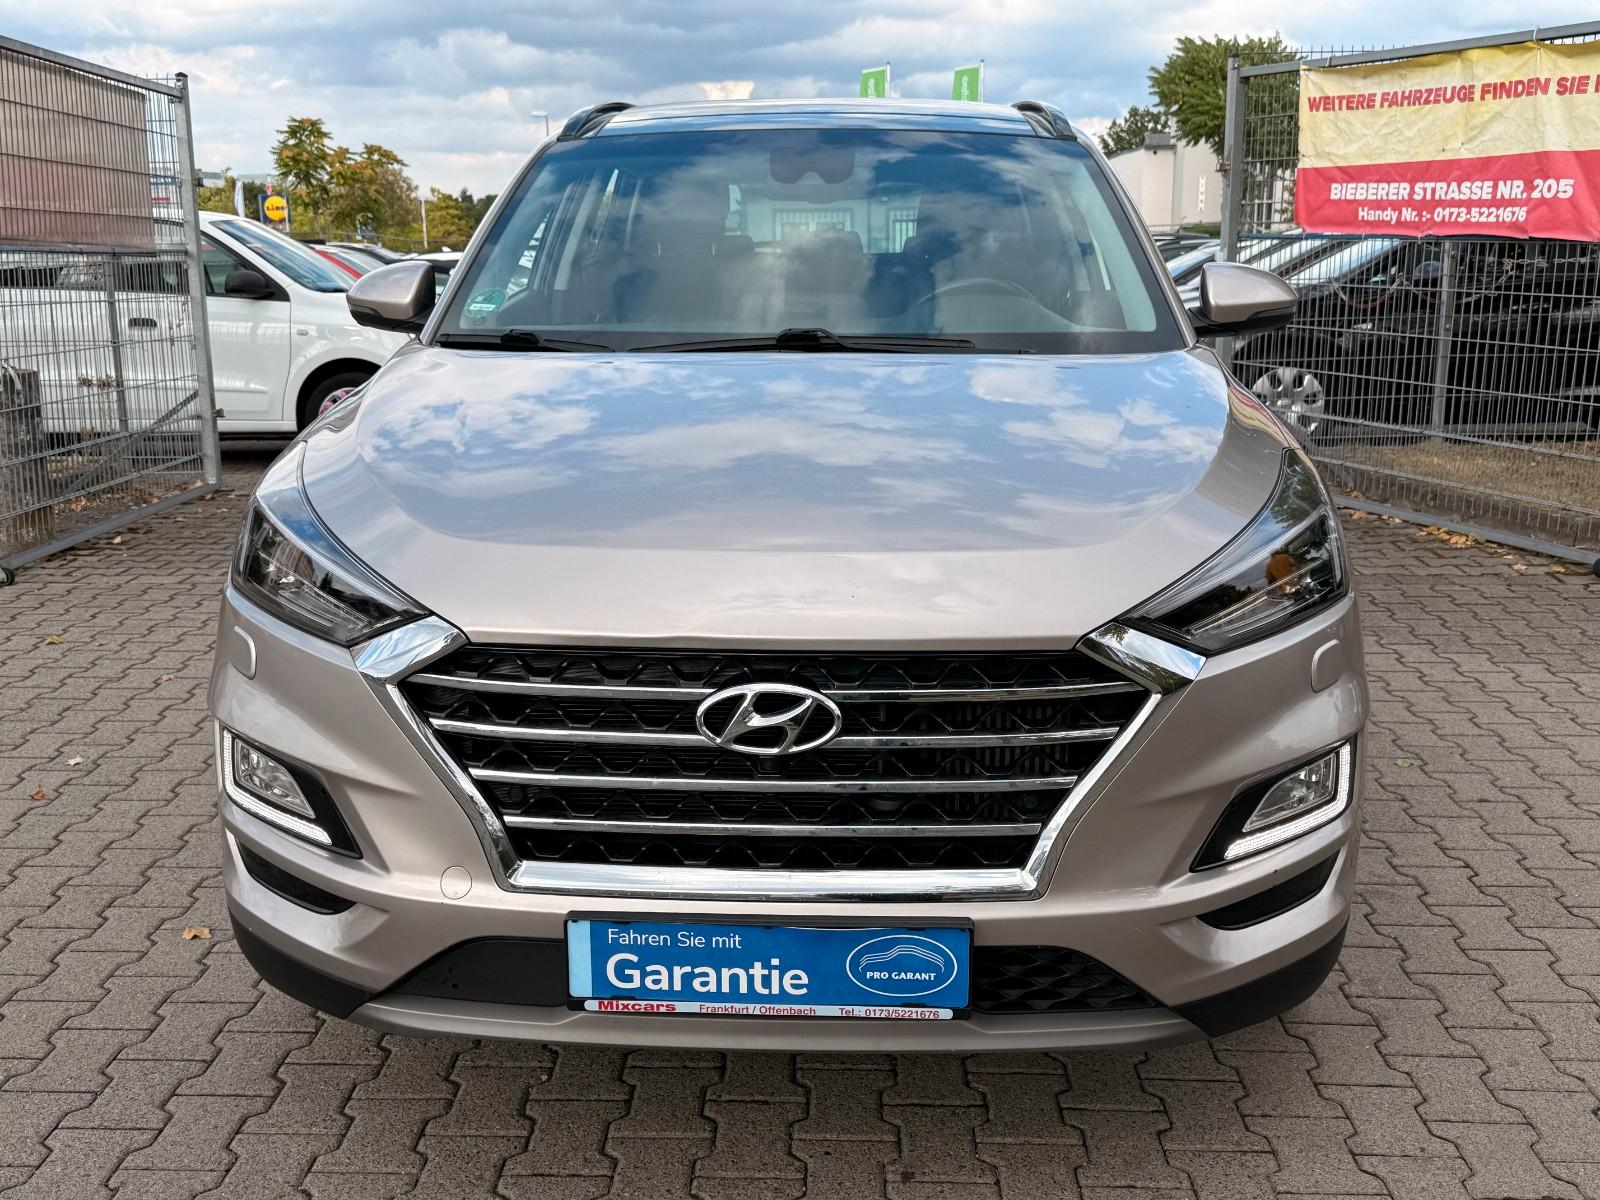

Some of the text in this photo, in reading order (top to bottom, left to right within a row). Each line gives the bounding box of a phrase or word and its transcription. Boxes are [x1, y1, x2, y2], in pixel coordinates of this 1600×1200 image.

[1308, 92, 1377, 112] WEITERE
[1380, 84, 1475, 108] FAHRZEUGE
[1480, 77, 1551, 101] FINDEN
[1556, 75, 1590, 96] SIE
[1330, 178, 1575, 200] BIEBERER STRASSE NR. 205
[1358, 206, 1398, 224] Handy
[1401, 207, 1418, 222] Nr.
[1433, 206, 1527, 222] 0173-5221676
[608, 928, 742, 949] Fahren Sie mit
[606, 952, 809, 995] Garantie
[866, 971, 937, 981] PRO GARANT
[598, 1000, 677, 1012] Mixcars
[699, 1004, 750, 1015] Frankfurt
[759, 1005, 816, 1017] Offenbach
[838, 1007, 861, 1017] Tel.:
[864, 1008, 940, 1019] 0173/5221676
